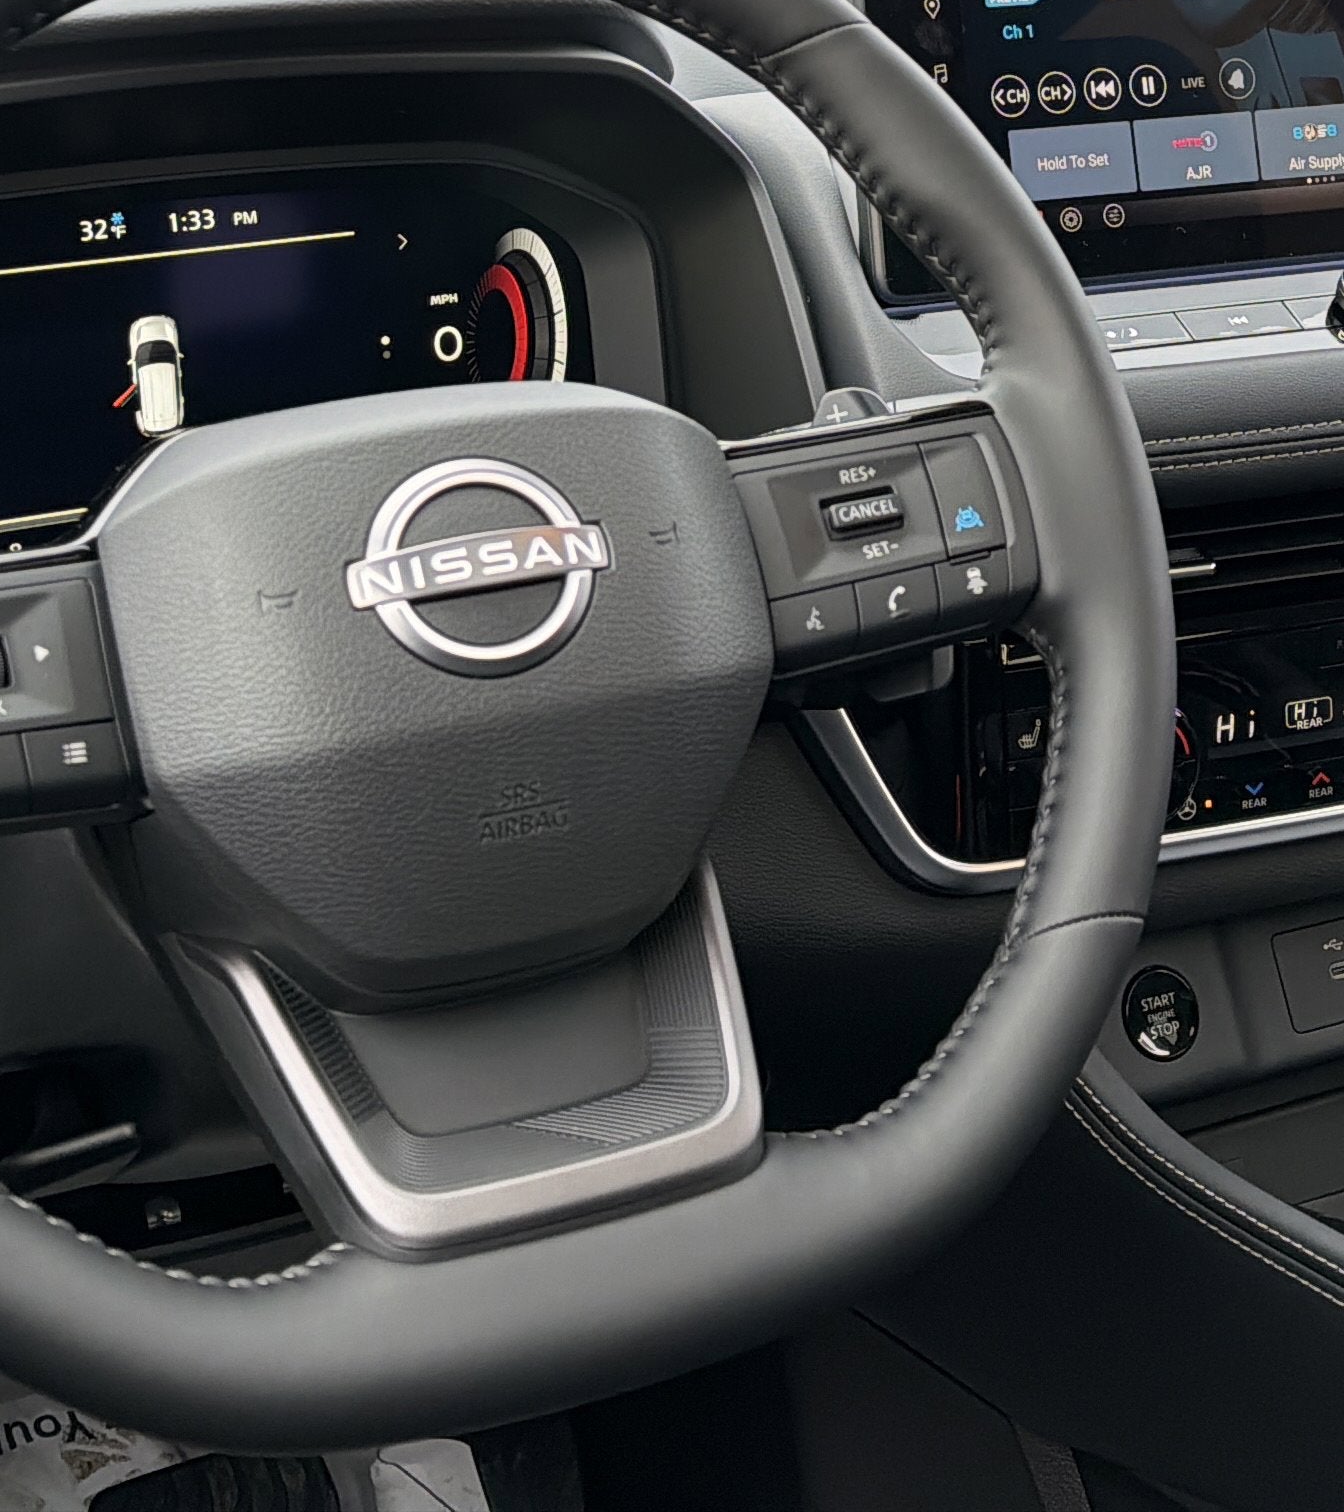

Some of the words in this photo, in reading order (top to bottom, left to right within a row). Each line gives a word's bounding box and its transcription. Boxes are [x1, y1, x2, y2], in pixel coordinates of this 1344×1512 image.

[1002, 24, 1023, 40] Ch
[1026, 23, 1035, 39] 1
[1181, 76, 1206, 90] LIVE
[1005, 87, 1027, 106] CH
[1040, 85, 1062, 103] CH
[1036, 155, 1068, 172] Hold
[1068, 154, 1087, 170] To
[1088, 152, 1110, 169] Set
[1288, 156, 1305, 171] Air
[1186, 164, 1213, 181] AJR
[168, 208, 216, 234] 1:33
[233, 209, 258, 227] PM
[429, 291, 459, 307] MPH
[433, 325, 463, 362] 0
[838, 498, 899, 523] CANCEL
[358, 530, 604, 601] NISSAN
[1295, 716, 1324, 730] REAR
[1308, 785, 1334, 799] REAR
[1241, 796, 1268, 810] REAR
[1140, 991, 1176, 1012] START
[1147, 1008, 1176, 1024] ENGINE
[1150, 1020, 1180, 1040] STOP
